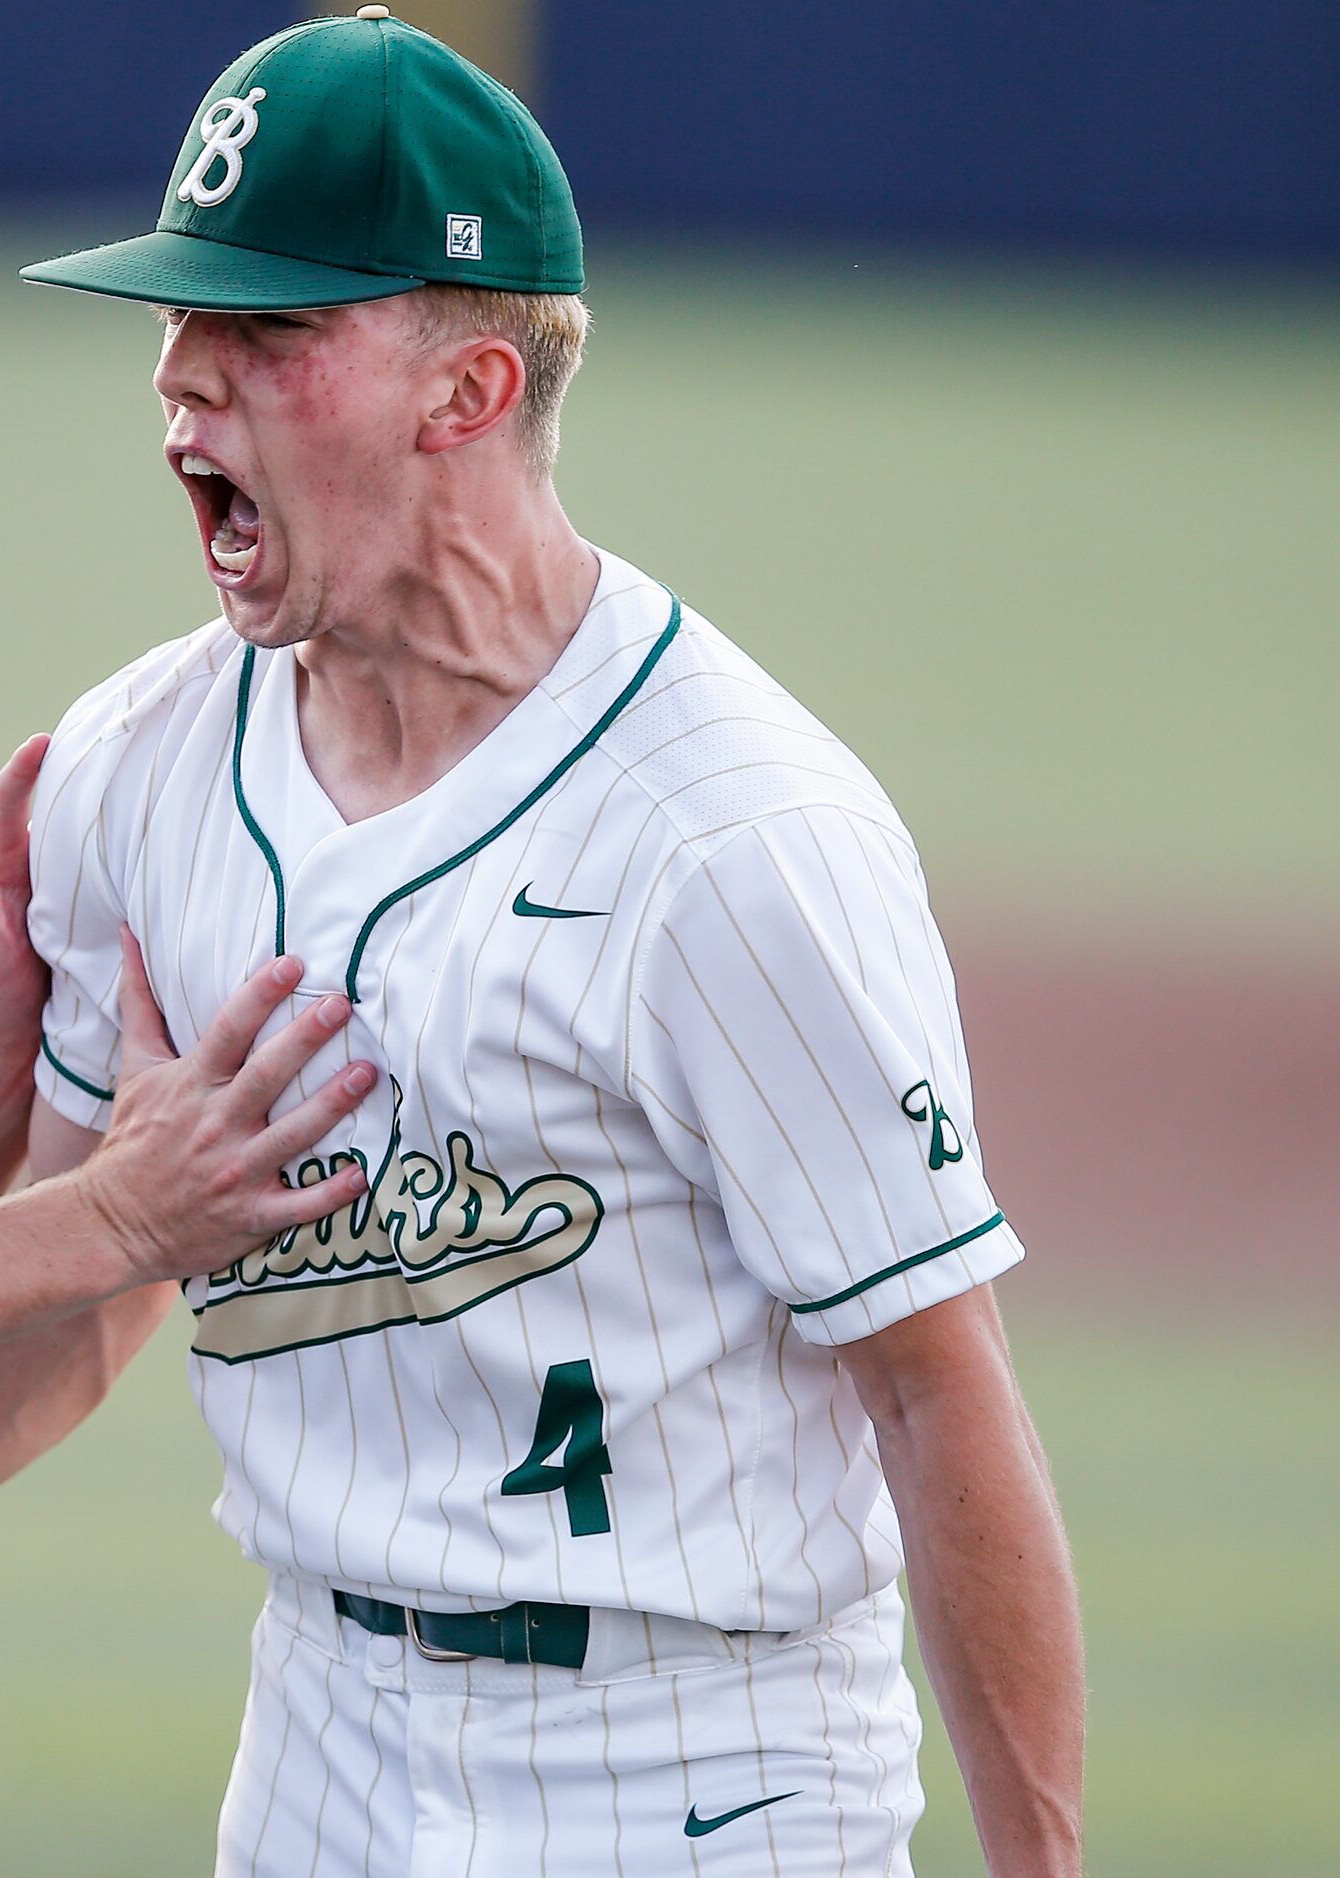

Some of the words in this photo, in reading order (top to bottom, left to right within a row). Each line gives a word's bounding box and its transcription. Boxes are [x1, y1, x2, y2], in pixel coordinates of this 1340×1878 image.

[177, 86, 267, 207] B
[901, 1079, 964, 1171] B
[501, 1358, 613, 1538] 4
